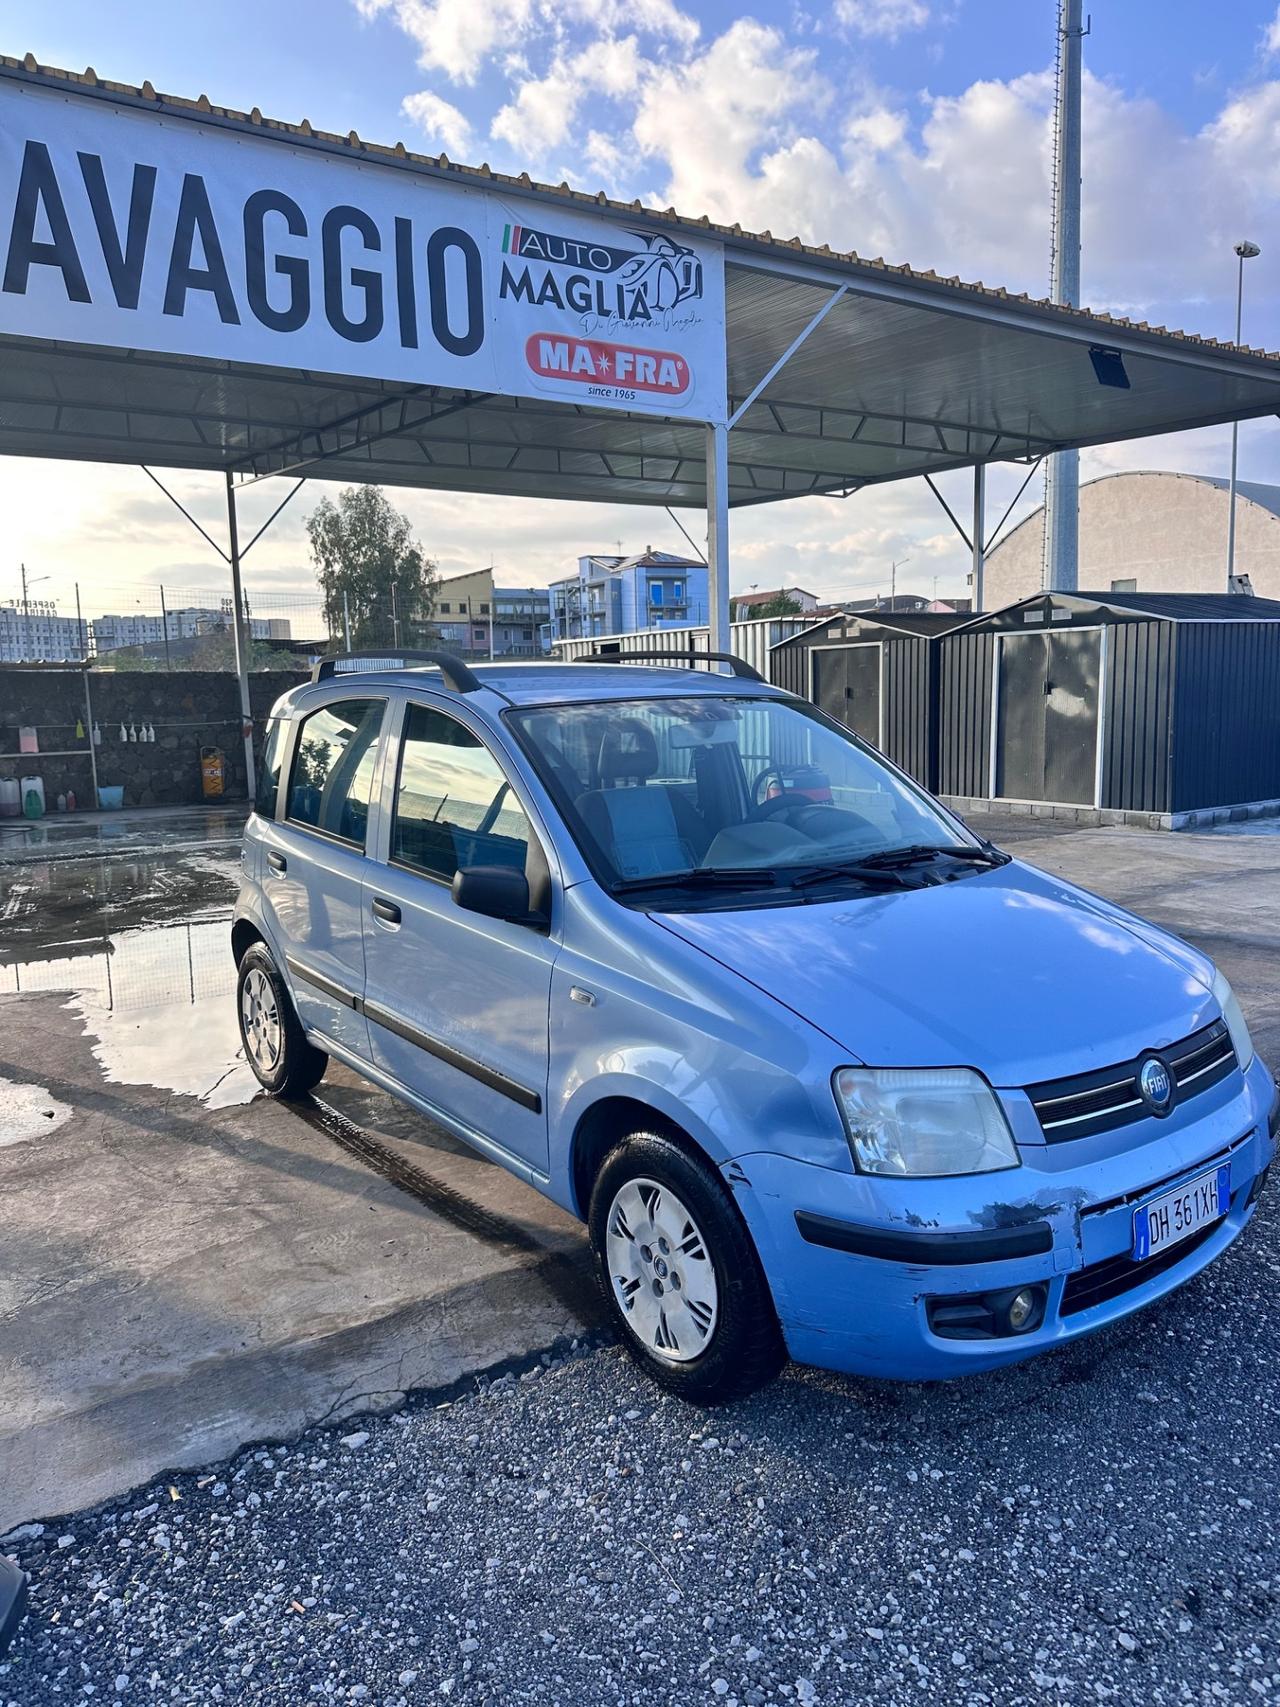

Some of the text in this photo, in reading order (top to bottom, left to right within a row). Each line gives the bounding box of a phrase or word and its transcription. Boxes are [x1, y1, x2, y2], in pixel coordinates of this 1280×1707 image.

[2, 139, 485, 357] AVAGGIO
[521, 232, 612, 271] AUTO
[499, 261, 651, 320] MAGLIA
[588, 387, 636, 400] since 1965
[1148, 1073, 1168, 1094] FIAT
[1149, 1205, 1170, 1246] DH
